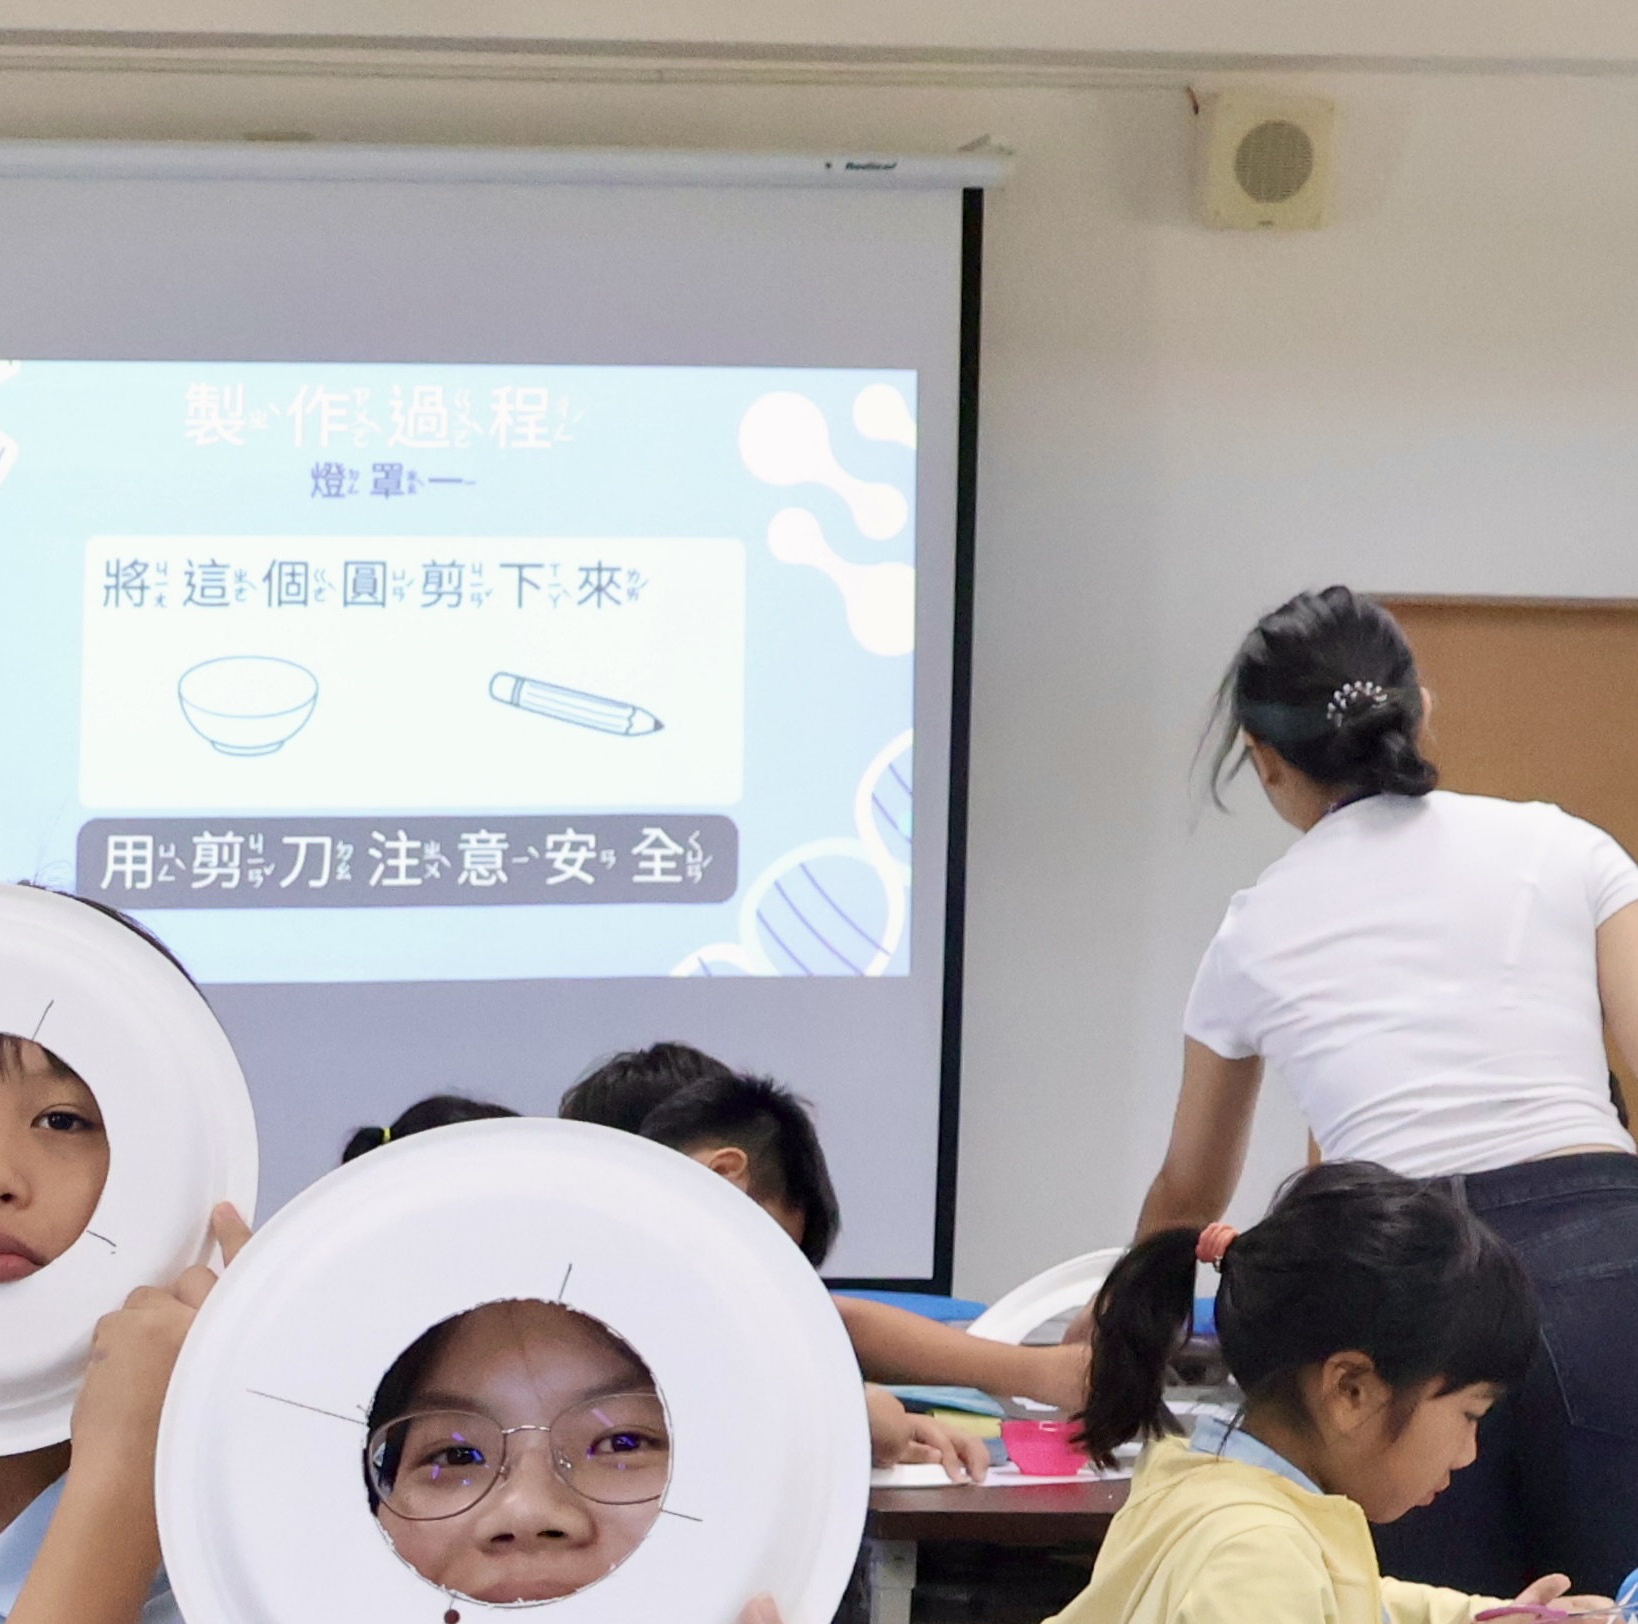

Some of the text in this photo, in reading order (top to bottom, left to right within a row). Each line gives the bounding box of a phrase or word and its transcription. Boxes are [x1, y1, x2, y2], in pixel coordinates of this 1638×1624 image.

[184, 382, 583, 449] 製作過程
[311, 462, 477, 499] 燈罩一
[103, 559, 647, 609] 將這個圓剪下來
[100, 828, 713, 890] 用剪刀注意安全
